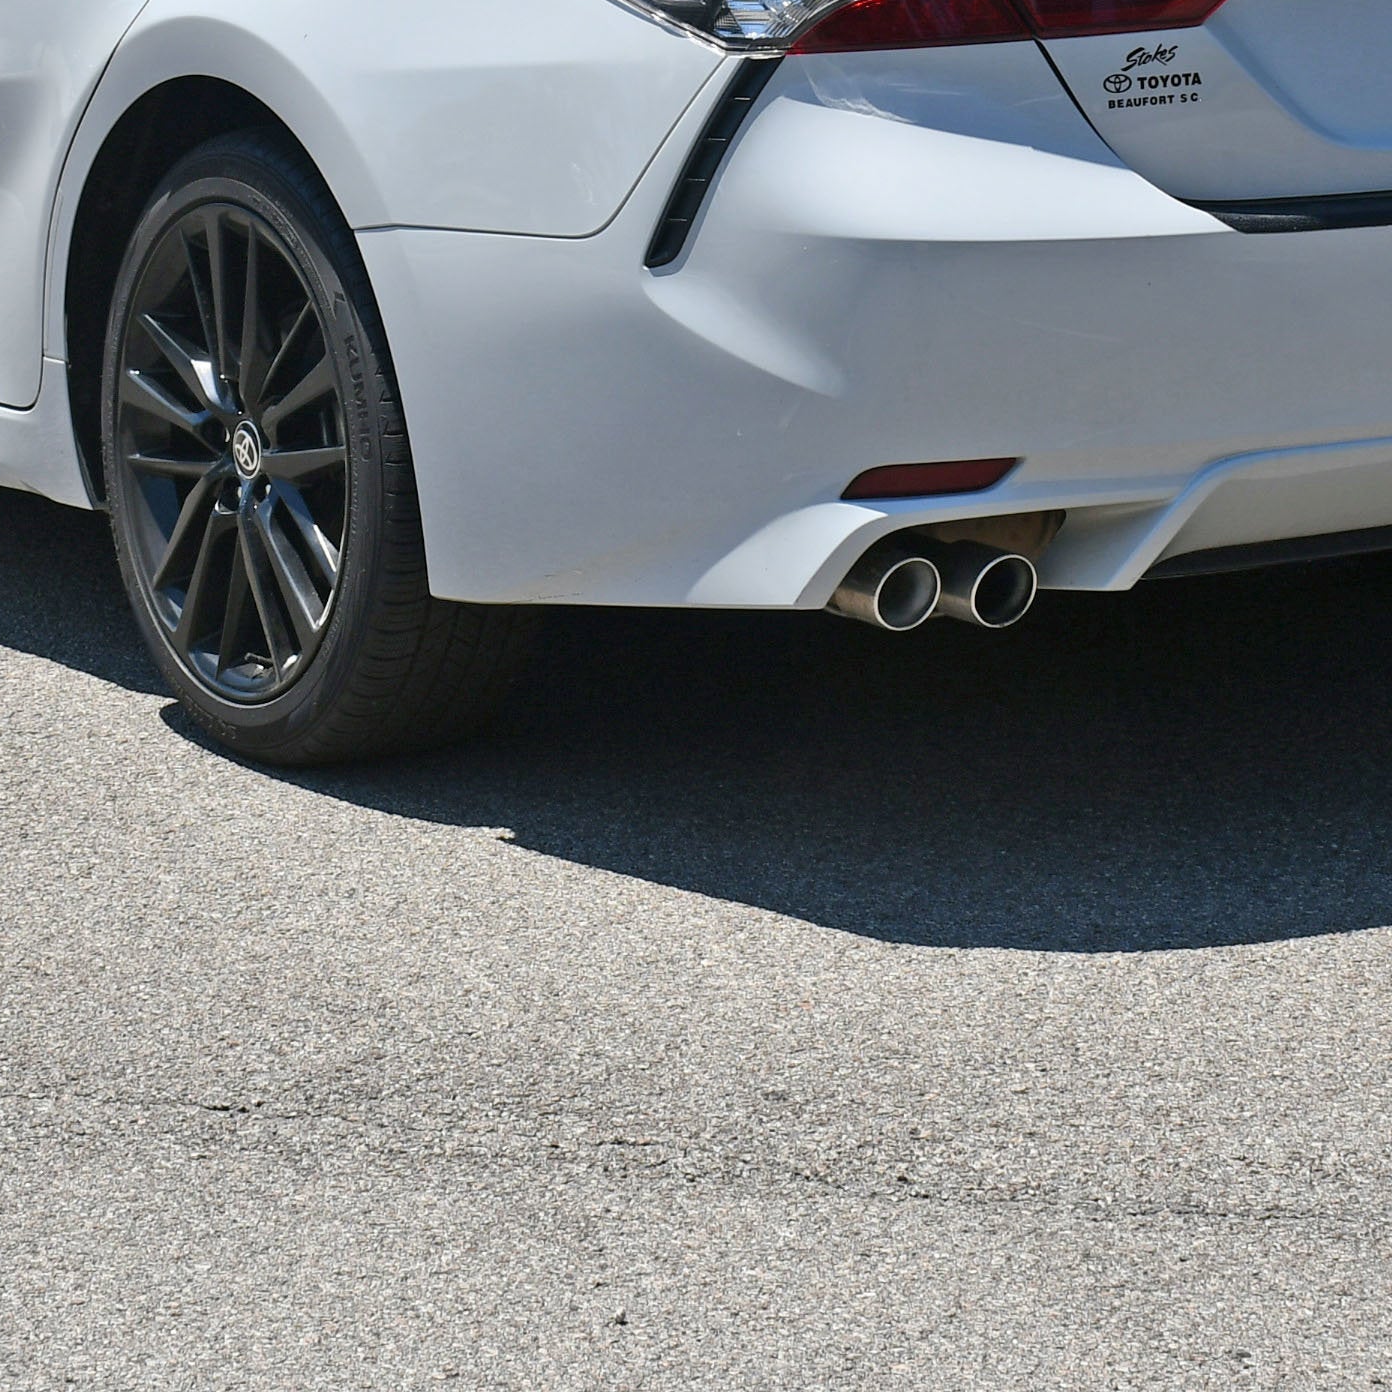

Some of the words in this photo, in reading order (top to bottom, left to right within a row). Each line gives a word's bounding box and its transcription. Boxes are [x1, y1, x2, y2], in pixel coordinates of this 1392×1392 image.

[1120, 43, 1179, 72] Stokes
[1137, 72, 1202, 90] TOYOTA
[1108, 95, 1175, 109] BEAUFORT
